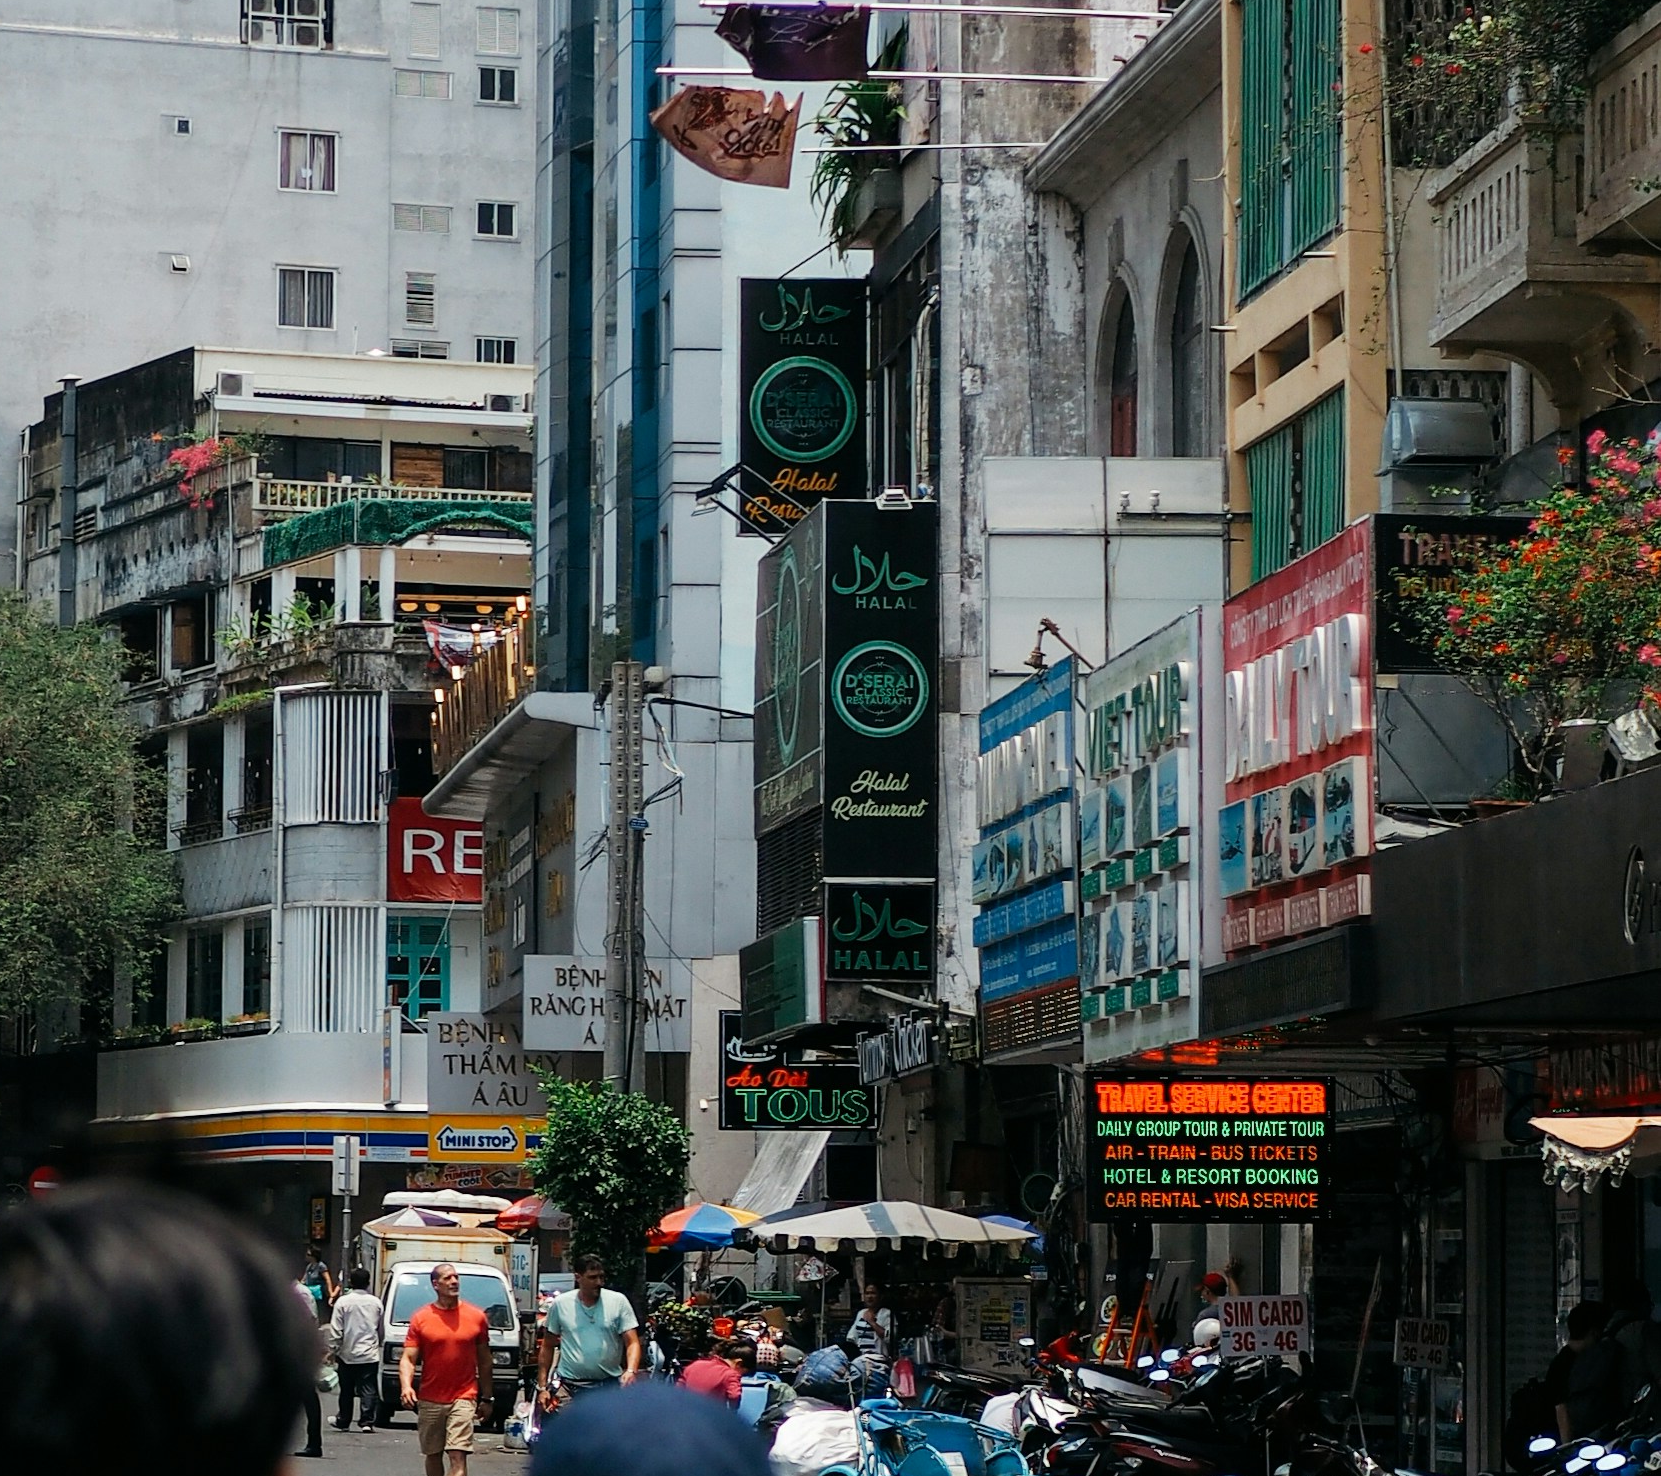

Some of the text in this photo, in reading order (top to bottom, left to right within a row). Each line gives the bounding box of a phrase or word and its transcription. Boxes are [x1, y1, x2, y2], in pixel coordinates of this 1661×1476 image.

[779, 332, 839, 346] HALAL
[765, 418, 841, 429] RESTAURANT
[777, 408, 831, 418] CLASSIC
[770, 467, 838, 493] Halal
[832, 544, 929, 595] حلال
[855, 596, 918, 610] HALAL
[845, 674, 915, 689] D'SERAI
[854, 688, 906, 698] CLASSIC
[846, 696, 914, 706] RESTAURANT
[1224, 643, 1293, 784] DAILY
[1293, 612, 1365, 756] TOUR
[1131, 661, 1190, 762] TOUR
[850, 769, 910, 794] Halal
[831, 795, 929, 821] Restaurant
[832, 890, 929, 942] حلال
[834, 950, 928, 971] HALAL
[529, 992, 586, 1017] RĂNG
[443, 1044, 517, 1076] THẨM
[726, 1064, 810, 1088] Áo Dài
[471, 1080, 529, 1108] Á ÂU
[735, 1088, 870, 1124] TOUS
[1096, 1084, 1168, 1113] TRAVEL
[1170, 1084, 1250, 1113] SERVICE
[1252, 1084, 1326, 1113] CENTER
[1097, 1121, 1325, 1137] DAILY GROUP TOUR & PRIVATE TOUR
[1105, 1145, 1134, 1161] AIR
[1147, 1145, 1196, 1161] TRAIN
[1211, 1145, 1244, 1161] BUS
[1249, 1145, 1318, 1161] TICKETS
[1104, 1168, 1319, 1185] HOTEL & RESORT BOOKING
[1105, 1192, 1137, 1208] CAR
[1141, 1192, 1201, 1208] RENTAL
[1214, 1192, 1249, 1208] VISA
[1253, 1192, 1319, 1208] SERVICE
[1223, 1300, 1304, 1327] SIM CARD
[1232, 1331, 1256, 1352] 3G
[1273, 1330, 1299, 1352] 4G
[1400, 1321, 1449, 1347] SIM CARD
[1402, 1346, 1418, 1363] 3G
[1427, 1348, 1443, 1365] 4G
